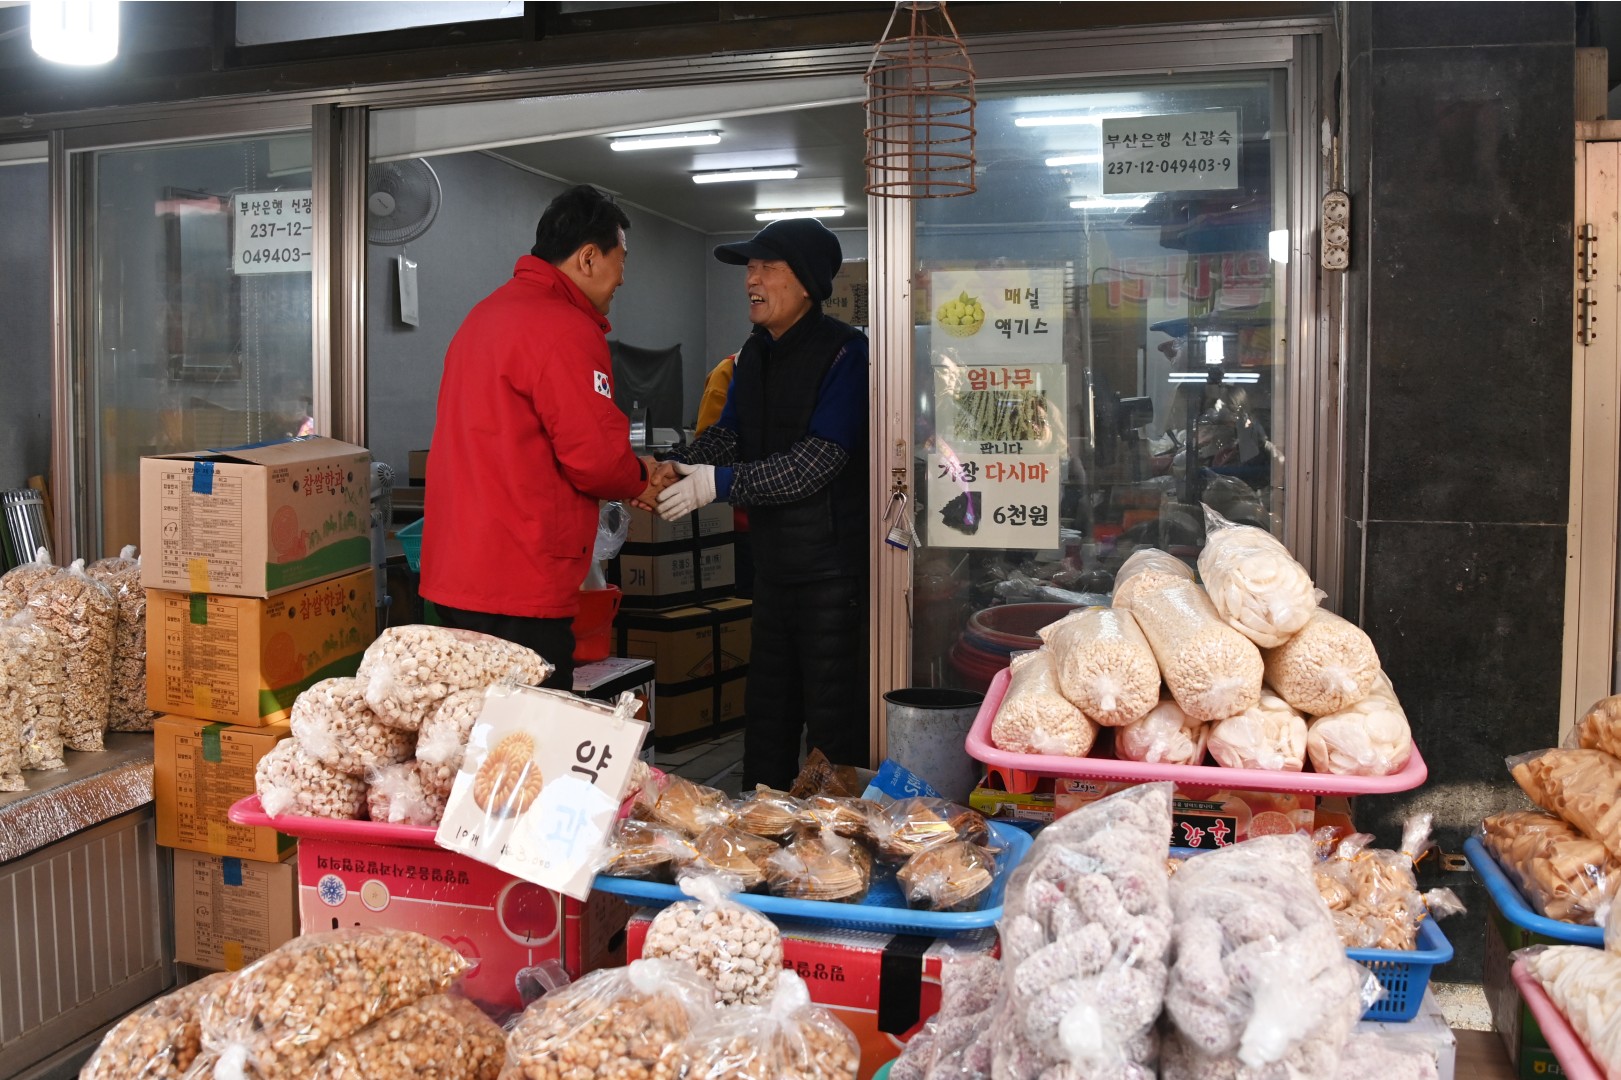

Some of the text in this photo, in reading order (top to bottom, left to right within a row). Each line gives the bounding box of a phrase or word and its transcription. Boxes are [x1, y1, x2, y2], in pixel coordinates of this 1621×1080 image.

[1105, 130, 1233, 149] 부산은행 신광숙
[240, 197, 312, 216] 부산은행 신광
[1004, 287, 1039, 310] 매실
[994, 317, 1048, 339] 액기스
[967, 367, 1034, 391] 엄나무
[980, 441, 1023, 454] 팝니다
[302, 468, 346, 497] 찹쌀한과
[938, 460, 1048, 483] 기장 다시마
[993, 504, 1048, 527] 6천원
[629, 568, 646, 587] 개
[300, 588, 346, 621] 찹쌀한과
[1072, 781, 1097, 792] Jeju
